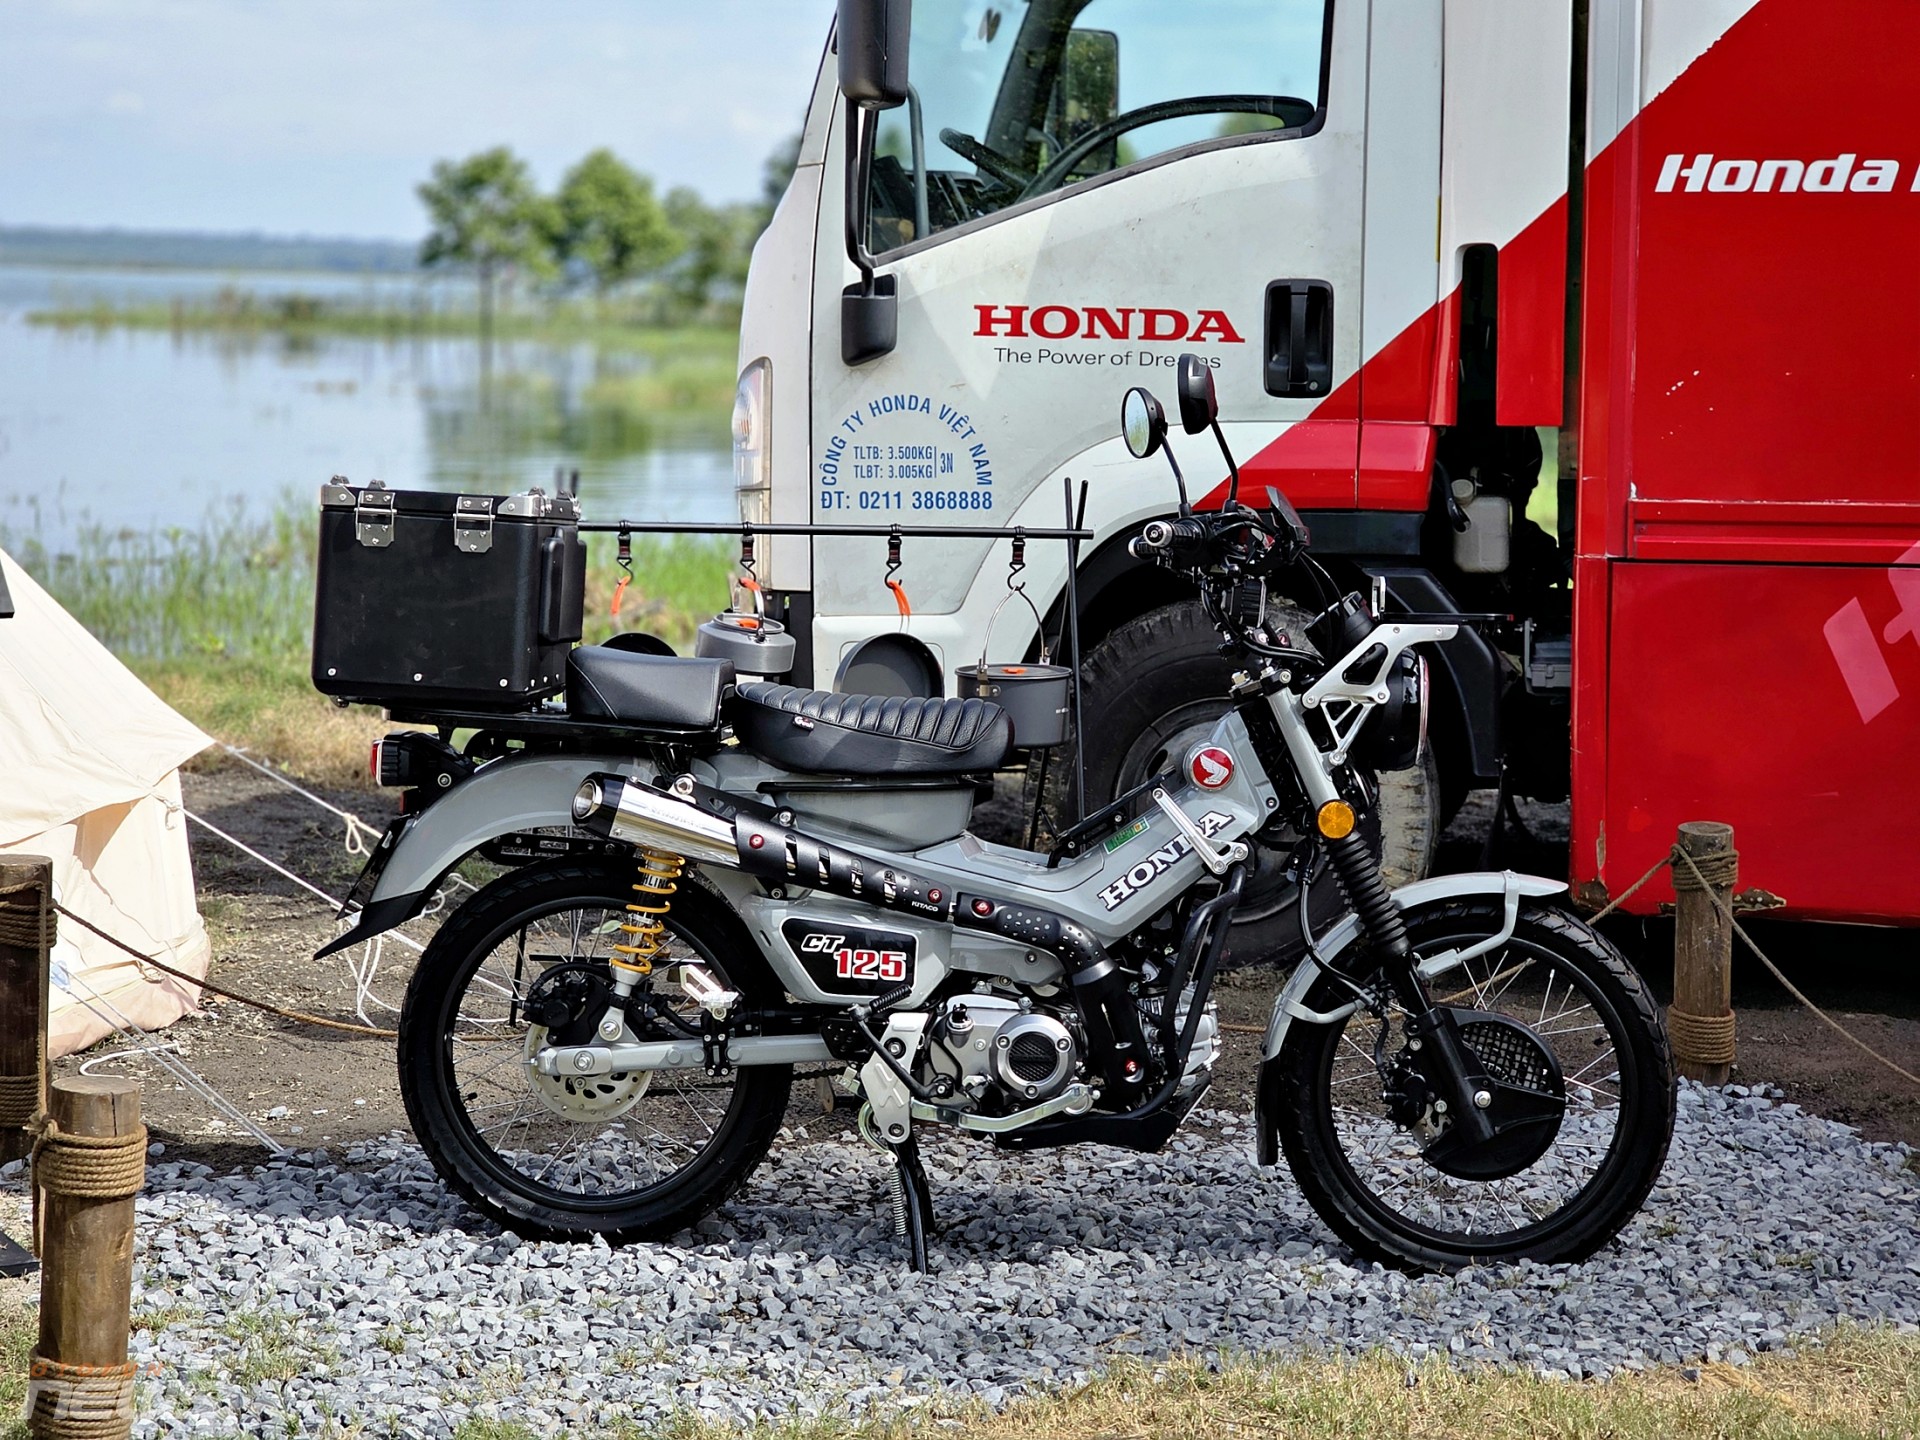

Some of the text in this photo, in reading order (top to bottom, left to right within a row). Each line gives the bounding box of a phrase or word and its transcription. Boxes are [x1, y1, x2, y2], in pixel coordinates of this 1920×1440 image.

[1654, 153, 1900, 193] Honda
[973, 304, 1246, 343] HONDA
[994, 347, 1221, 368] The Power of Dres
[819, 394, 993, 486] CÔNG TY HONDA VIỆT NAM
[853, 446, 933, 460] TLTB: 3.500KG
[939, 452, 954, 474] 3N
[853, 464, 933, 479] TLBT: 3.005KG
[821, 490, 993, 510] ĐT: 0211 3868888
[1096, 810, 1237, 912] HONA
[911, 900, 939, 912] KITACO
[801, 933, 846, 953] CT
[833, 949, 907, 982] 125
